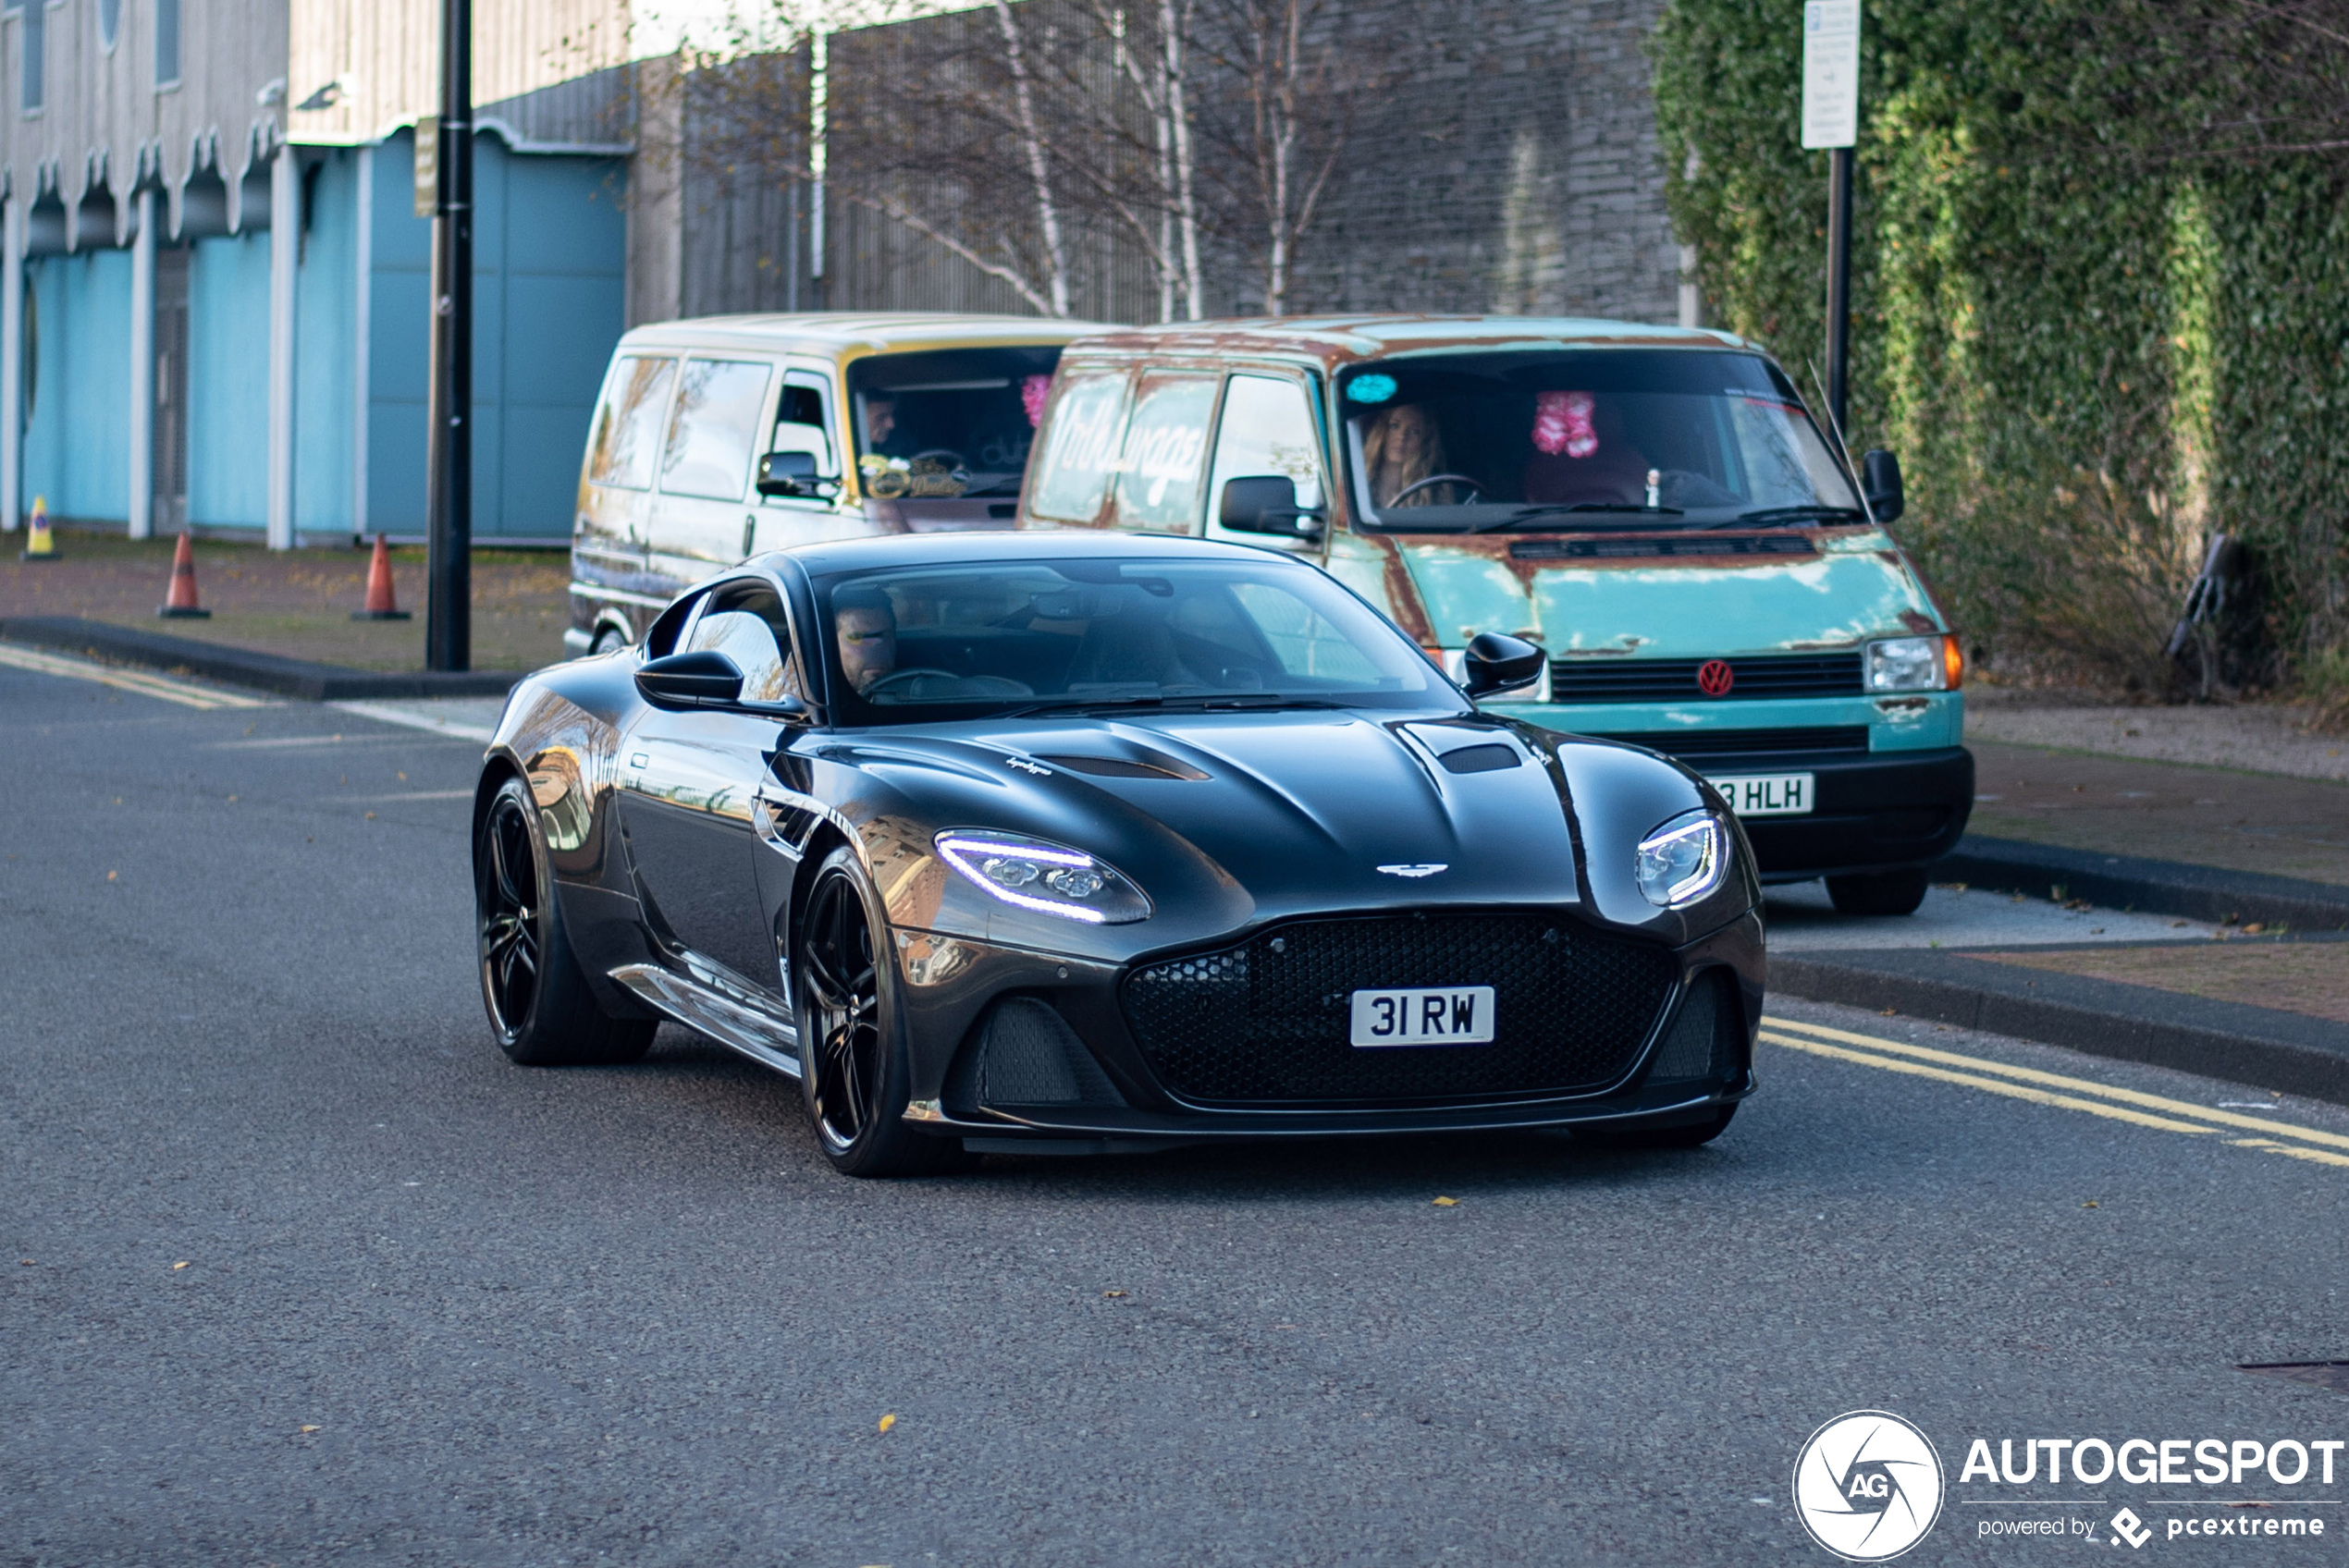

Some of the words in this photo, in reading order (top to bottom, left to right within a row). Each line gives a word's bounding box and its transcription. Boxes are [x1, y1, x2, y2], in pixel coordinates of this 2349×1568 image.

[1711, 782, 1736, 810] 3
[1745, 779, 1802, 810] HLH
[1371, 996, 1408, 1036] 31
[1421, 994, 1475, 1035] RW
